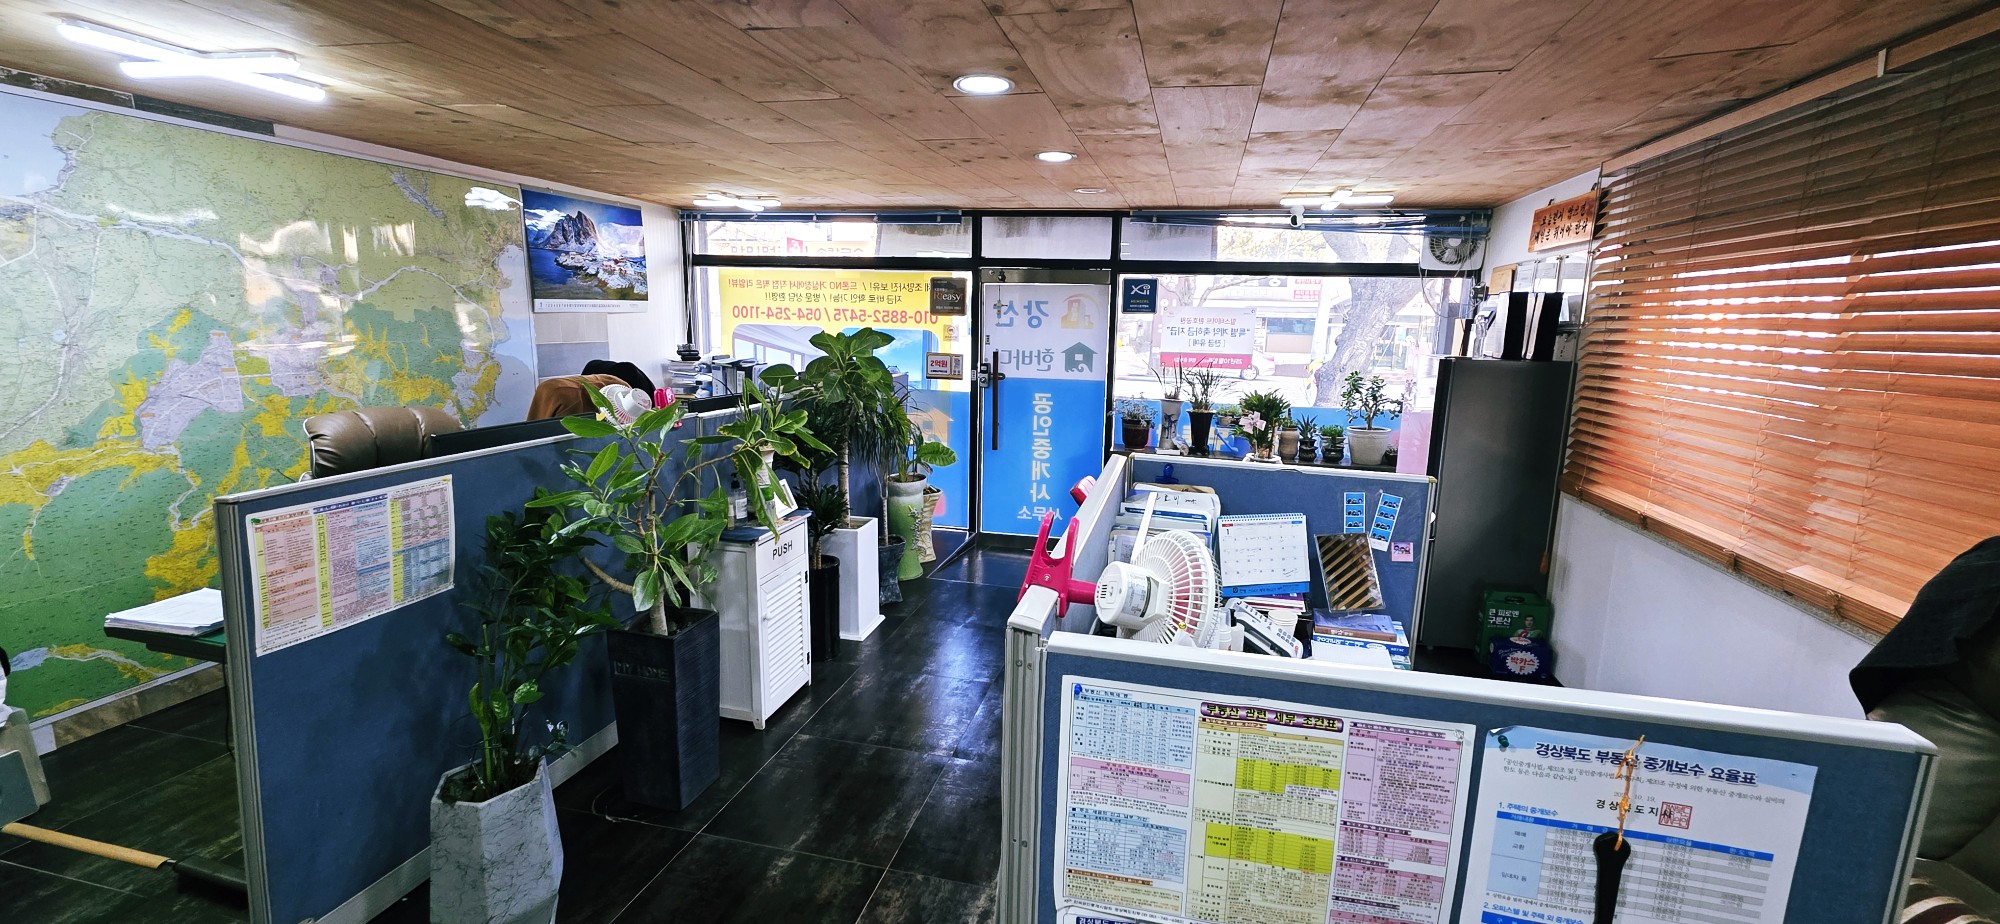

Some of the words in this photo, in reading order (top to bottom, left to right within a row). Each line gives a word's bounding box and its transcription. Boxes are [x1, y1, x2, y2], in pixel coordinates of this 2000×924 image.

[772, 540, 793, 560] PUSH
[1510, 657, 1535, 666] 박카스
[1207, 704, 1240, 717] 부동산
[1245, 708, 1268, 720] 관련
[1273, 711, 1296, 723] 세무
[1302, 714, 1338, 728] 조견표
[1536, 742, 1591, 761] 경상북도
[1643, 758, 1705, 776] 중개보수
[1708, 767, 1756, 785] 요율표
[1492, 904, 1520, 915] 오피스텔
